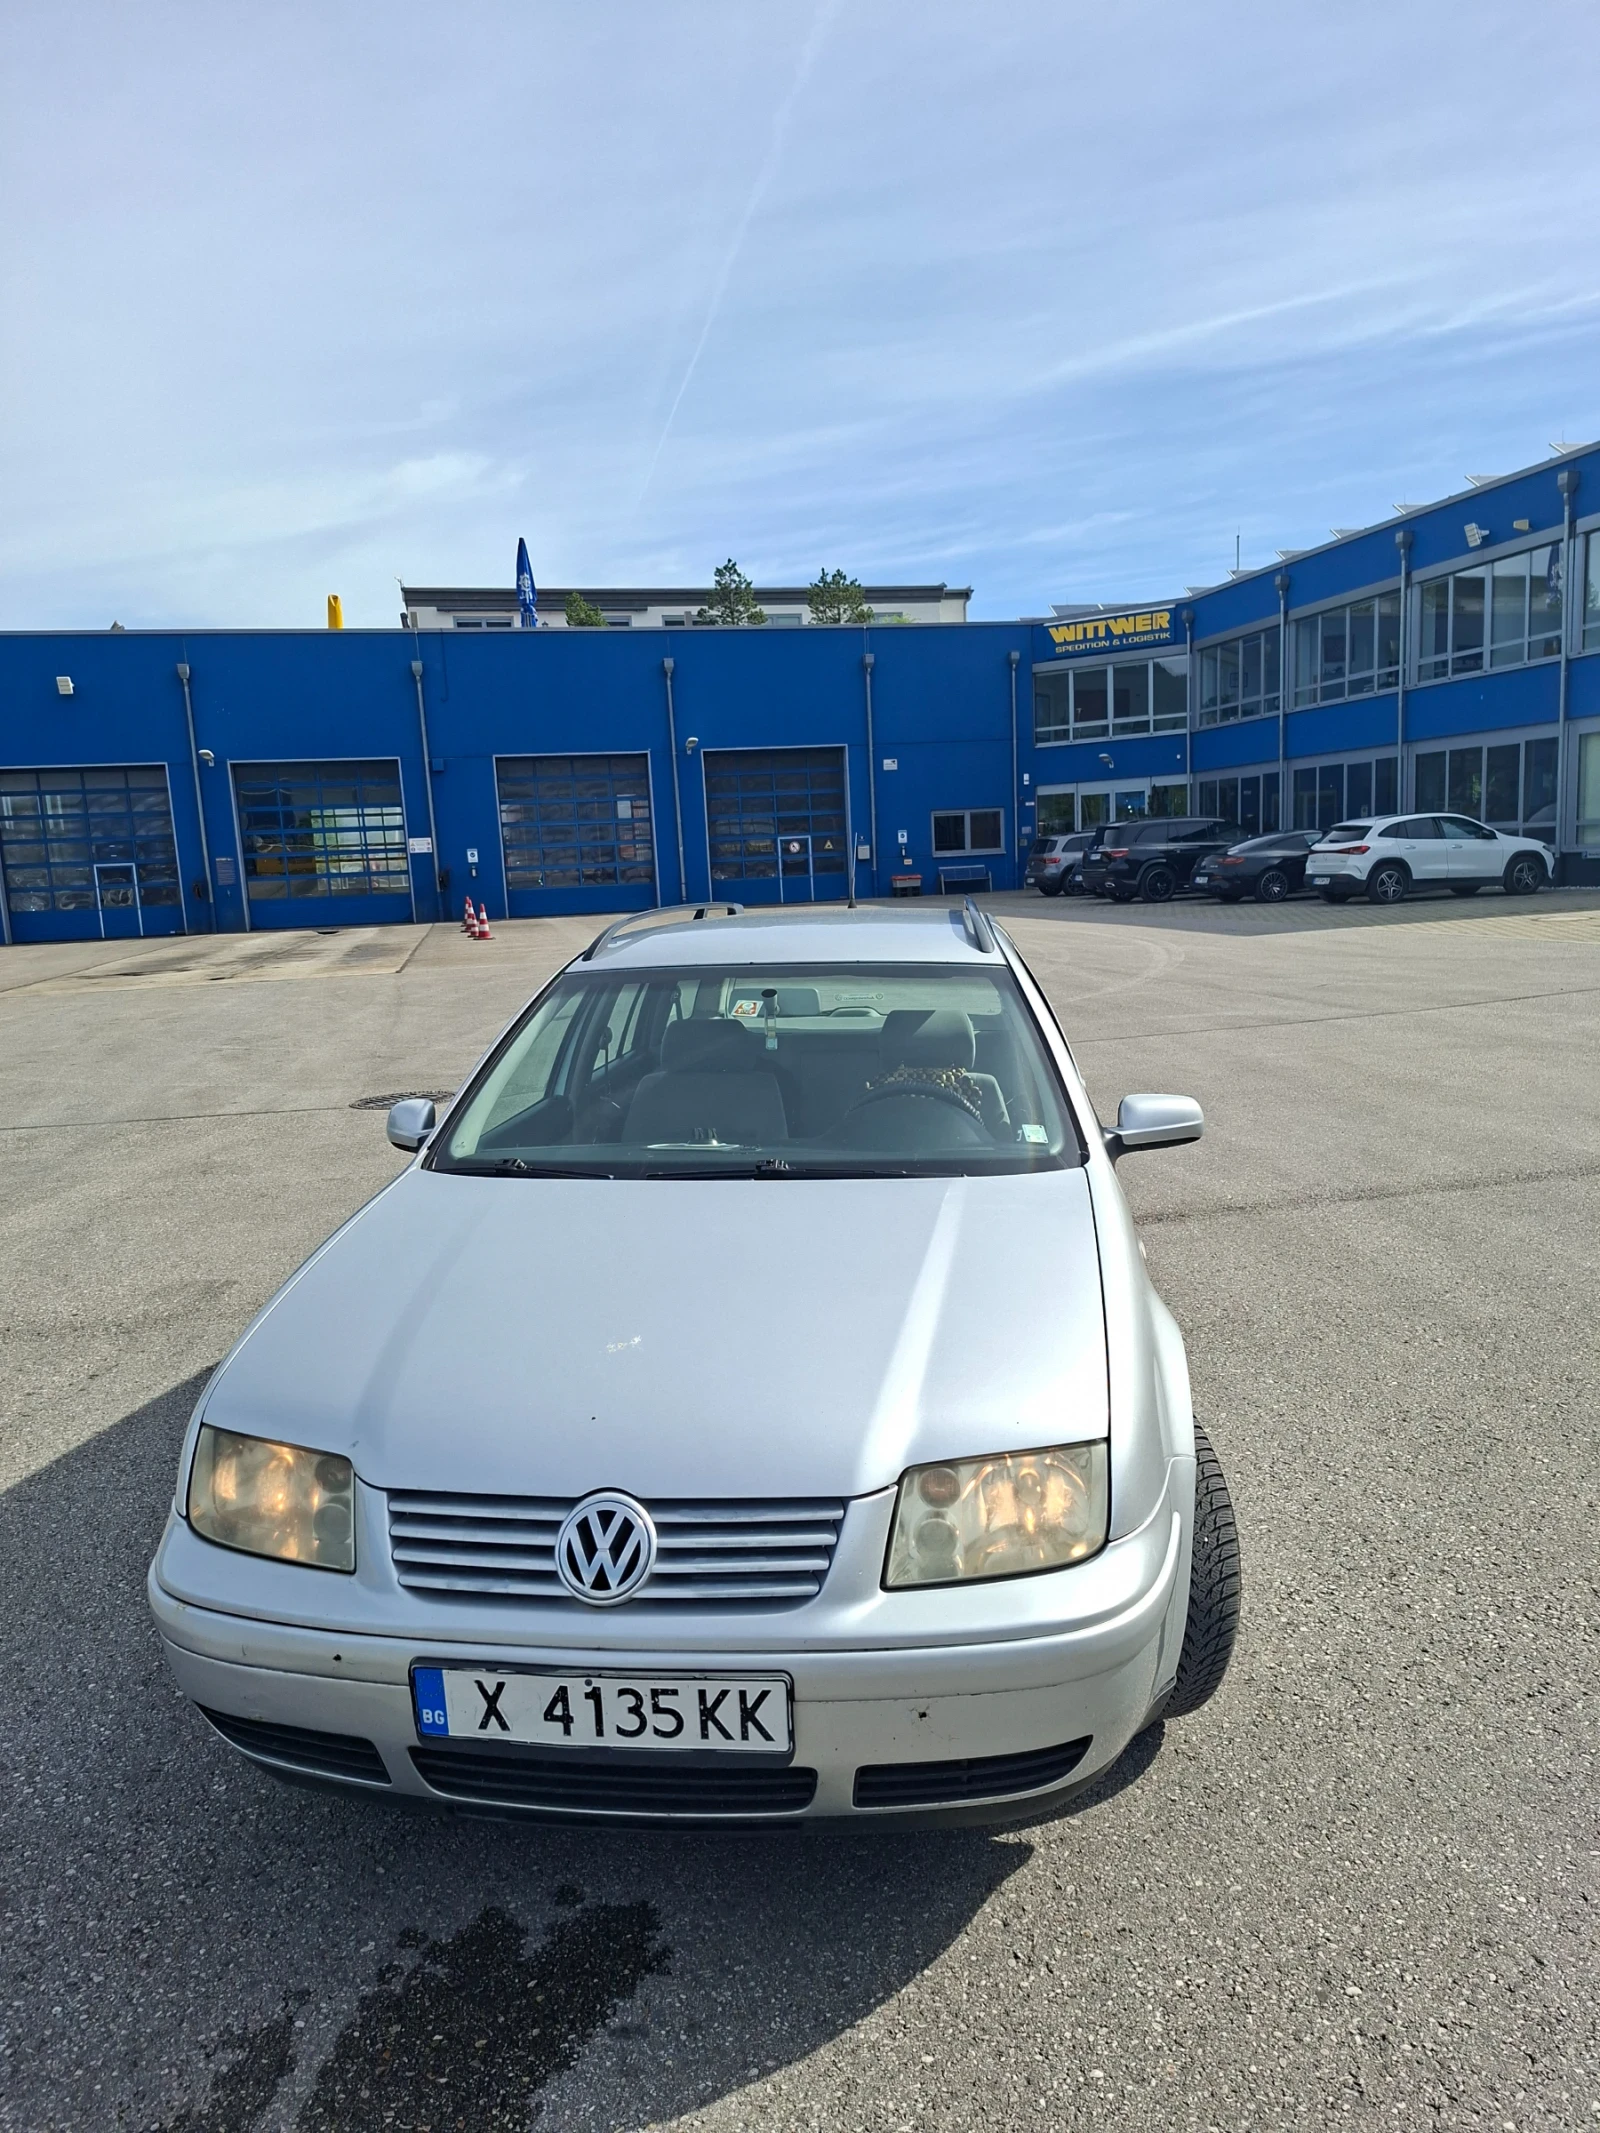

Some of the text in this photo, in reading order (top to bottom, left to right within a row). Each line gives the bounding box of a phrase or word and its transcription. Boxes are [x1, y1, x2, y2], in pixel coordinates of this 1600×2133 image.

[1049, 611, 1170, 643] WITTWER
[1056, 632, 1170, 653] SPEDITION & LOGISTIK
[422, 1708, 445, 1725] BG
[474, 1679, 511, 1732] X
